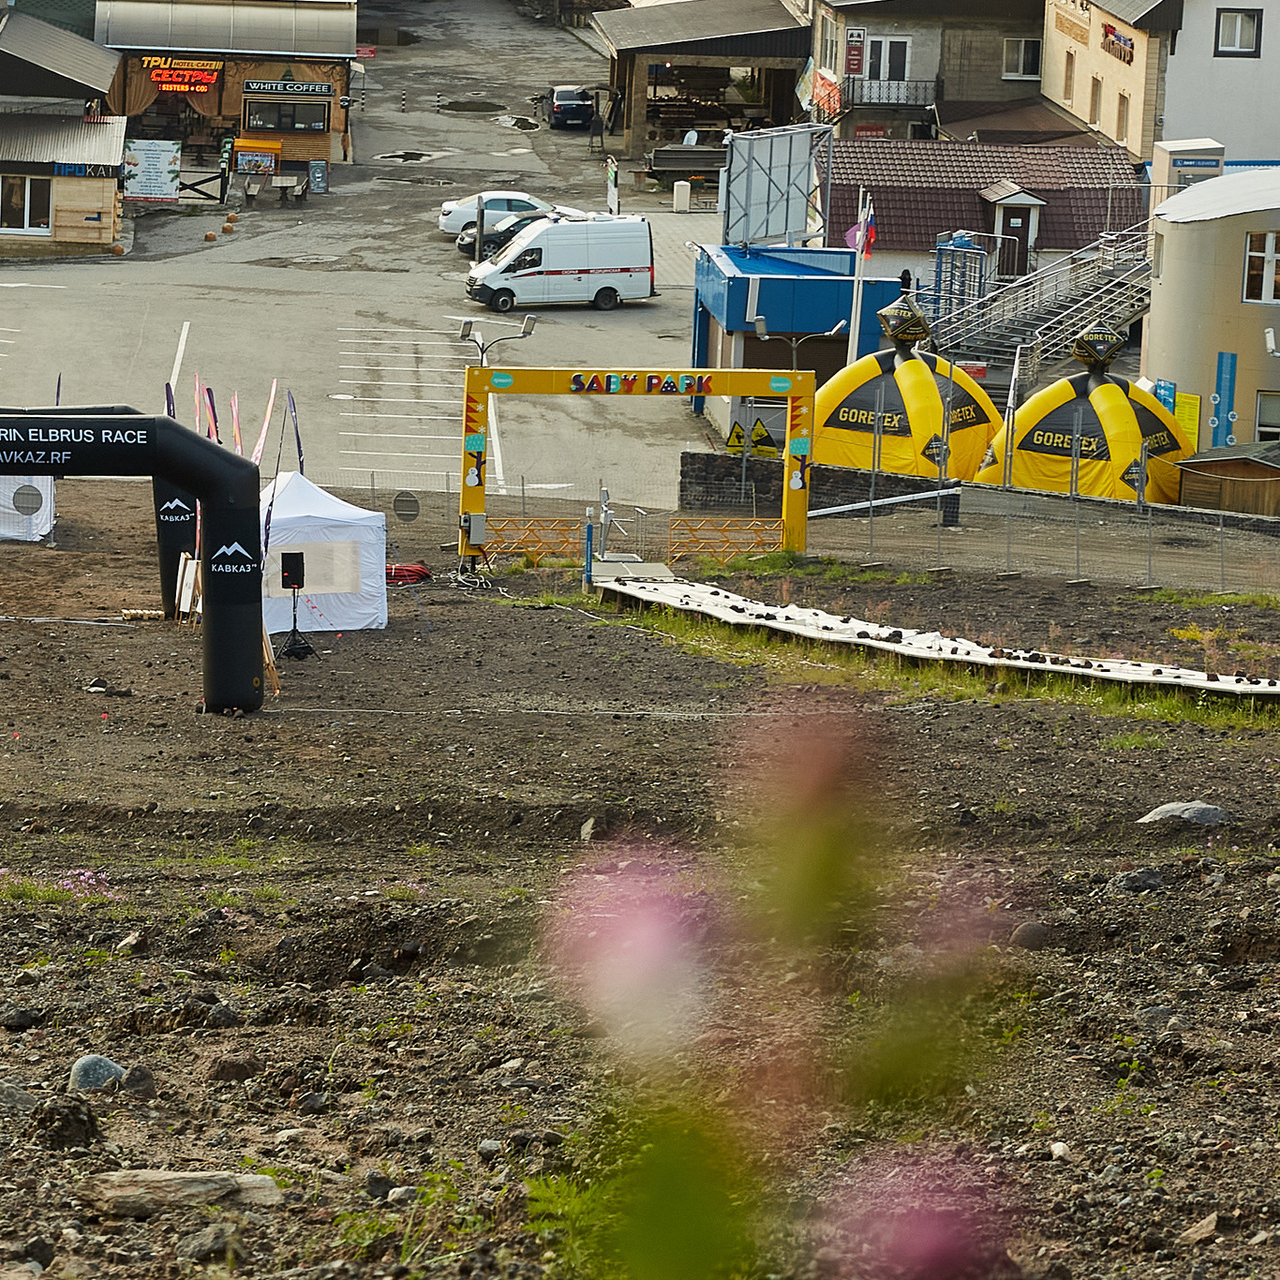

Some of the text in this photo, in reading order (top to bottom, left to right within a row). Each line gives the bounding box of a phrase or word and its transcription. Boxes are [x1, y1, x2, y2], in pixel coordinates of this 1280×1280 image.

[150, 69, 218, 83] СЕСТРЫ
[249, 82, 328, 92] WHITE COFFEE
[570, 373, 712, 394] SABY PARK
[28, 428, 94, 443] ELBRUS
[102, 429, 147, 444] RACE
[160, 514, 190, 522] КАВКАЗ
[211, 563, 251, 573] КАВКАЗ
